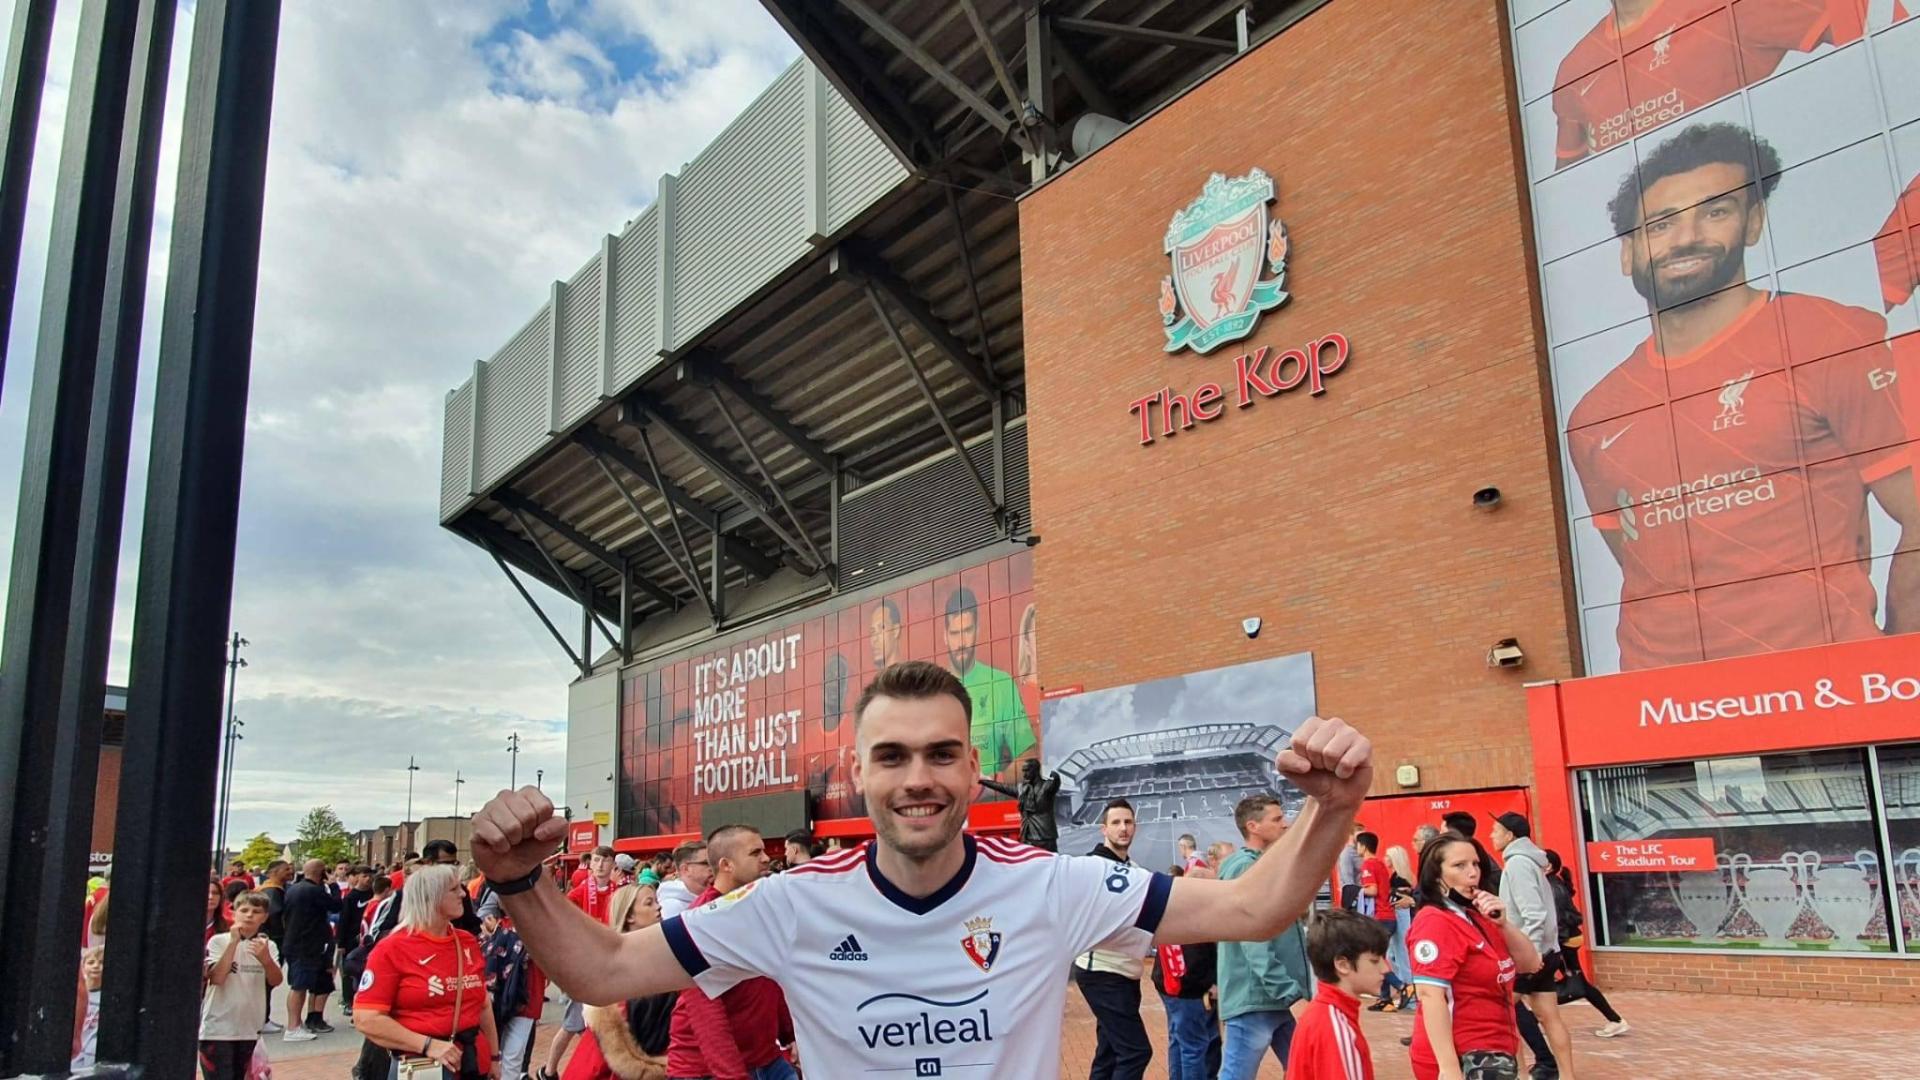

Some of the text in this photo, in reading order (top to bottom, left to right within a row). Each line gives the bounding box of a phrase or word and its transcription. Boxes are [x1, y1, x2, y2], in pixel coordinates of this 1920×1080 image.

[1600, 87, 1677, 134] standard
[1600, 100, 1685, 147] chartered
[1182, 221, 1258, 271] LIVERPOOL
[1129, 332, 1350, 445] The Kop
[1713, 414, 1747, 431] LFC
[1641, 465, 1761, 508] standard
[1643, 479, 1776, 528] chartered
[695, 633, 801, 695] IT'S ABOUT
[694, 686, 747, 729] MORE
[1639, 673, 1920, 727] Museum & Bo
[693, 709, 802, 762] THAN JUST
[693, 749, 799, 796] FOOTBALL.
[1615, 843, 1664, 855] The LFC
[1616, 855, 1696, 867] Stadium Tour
[829, 951, 868, 961] adidas
[858, 1008, 993, 1049] verleal
